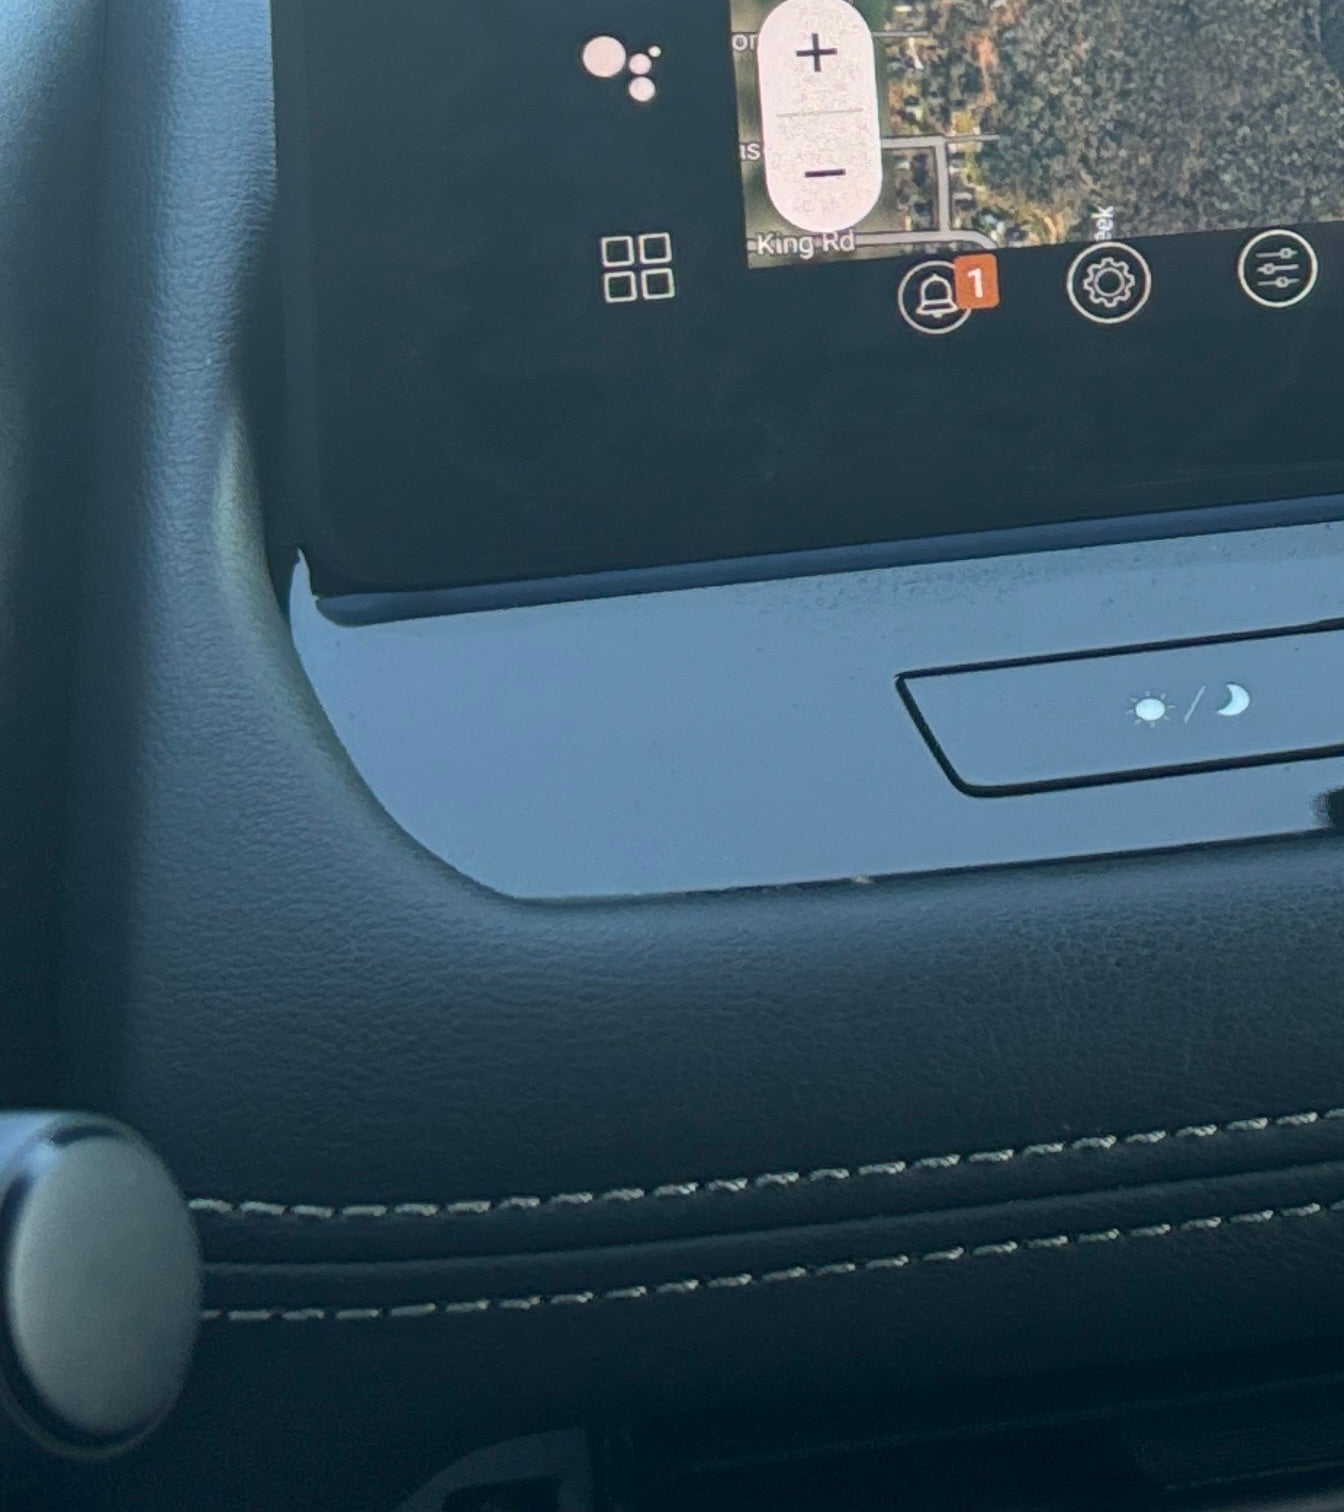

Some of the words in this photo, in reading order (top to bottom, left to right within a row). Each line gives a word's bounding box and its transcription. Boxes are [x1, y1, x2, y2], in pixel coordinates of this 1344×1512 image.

[757, 231, 815, 260] King
[822, 229, 855, 252] Rd
[967, 268, 984, 298] 1
